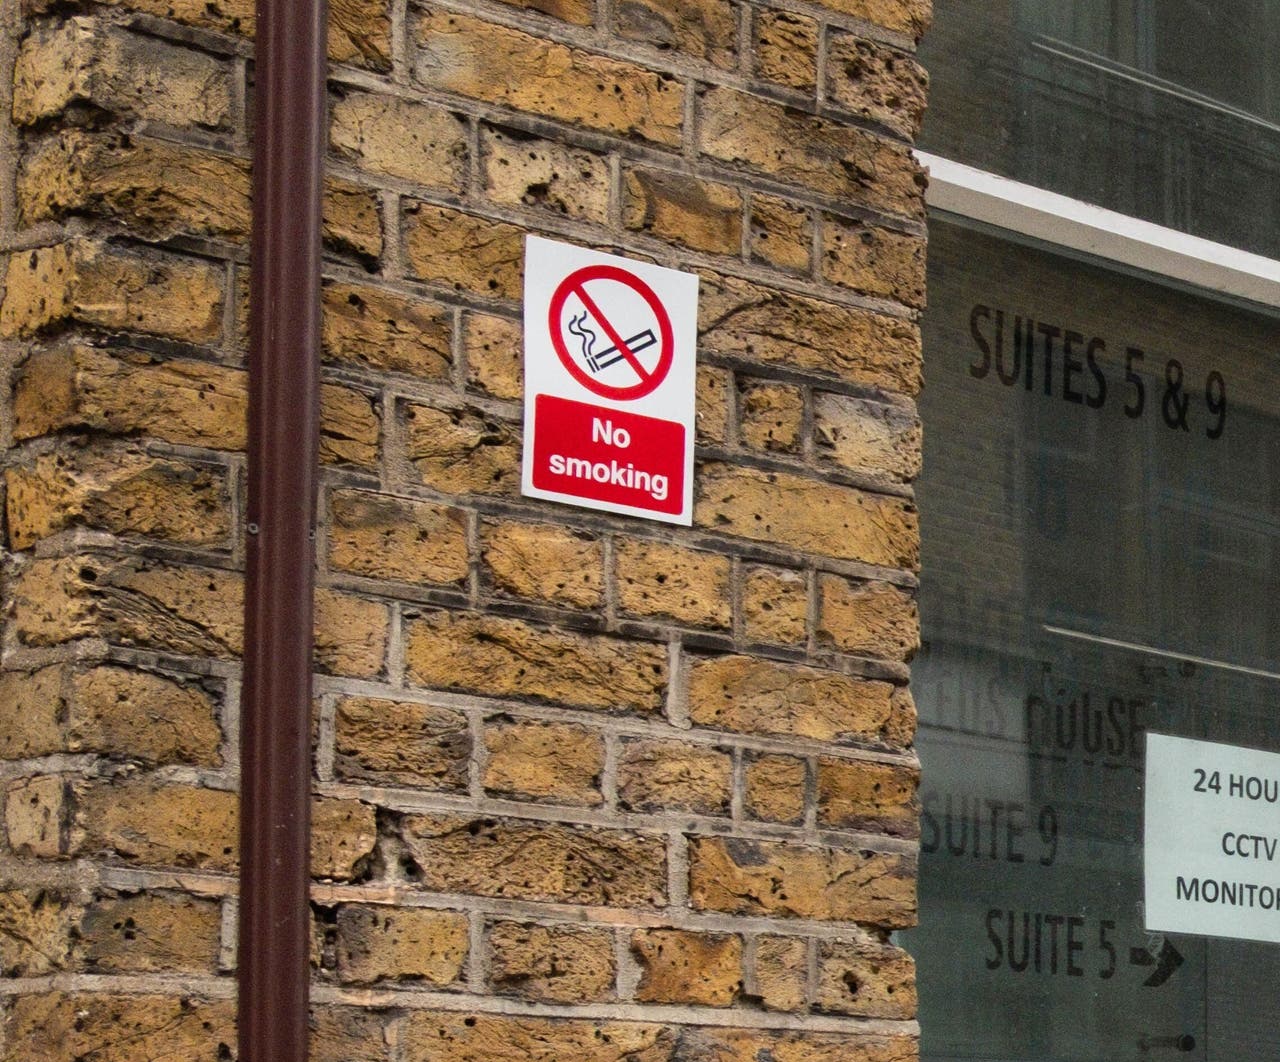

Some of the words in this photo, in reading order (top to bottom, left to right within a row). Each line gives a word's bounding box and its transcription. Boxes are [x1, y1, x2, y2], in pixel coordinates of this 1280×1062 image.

[969, 303, 1107, 410] SUITES
[1124, 346, 1146, 420] 5
[1161, 358, 1190, 433] &
[1205, 370, 1228, 440] 9
[591, 417, 632, 449] No
[548, 453, 669, 501] smoking
[1193, 768, 1222, 795] 24
[919, 790, 1025, 864] SUITE
[1038, 804, 1058, 867] 9
[1221, 831, 1279, 862] CCTV
[985, 908, 1085, 977] SUITE
[1099, 919, 1117, 980] 5
